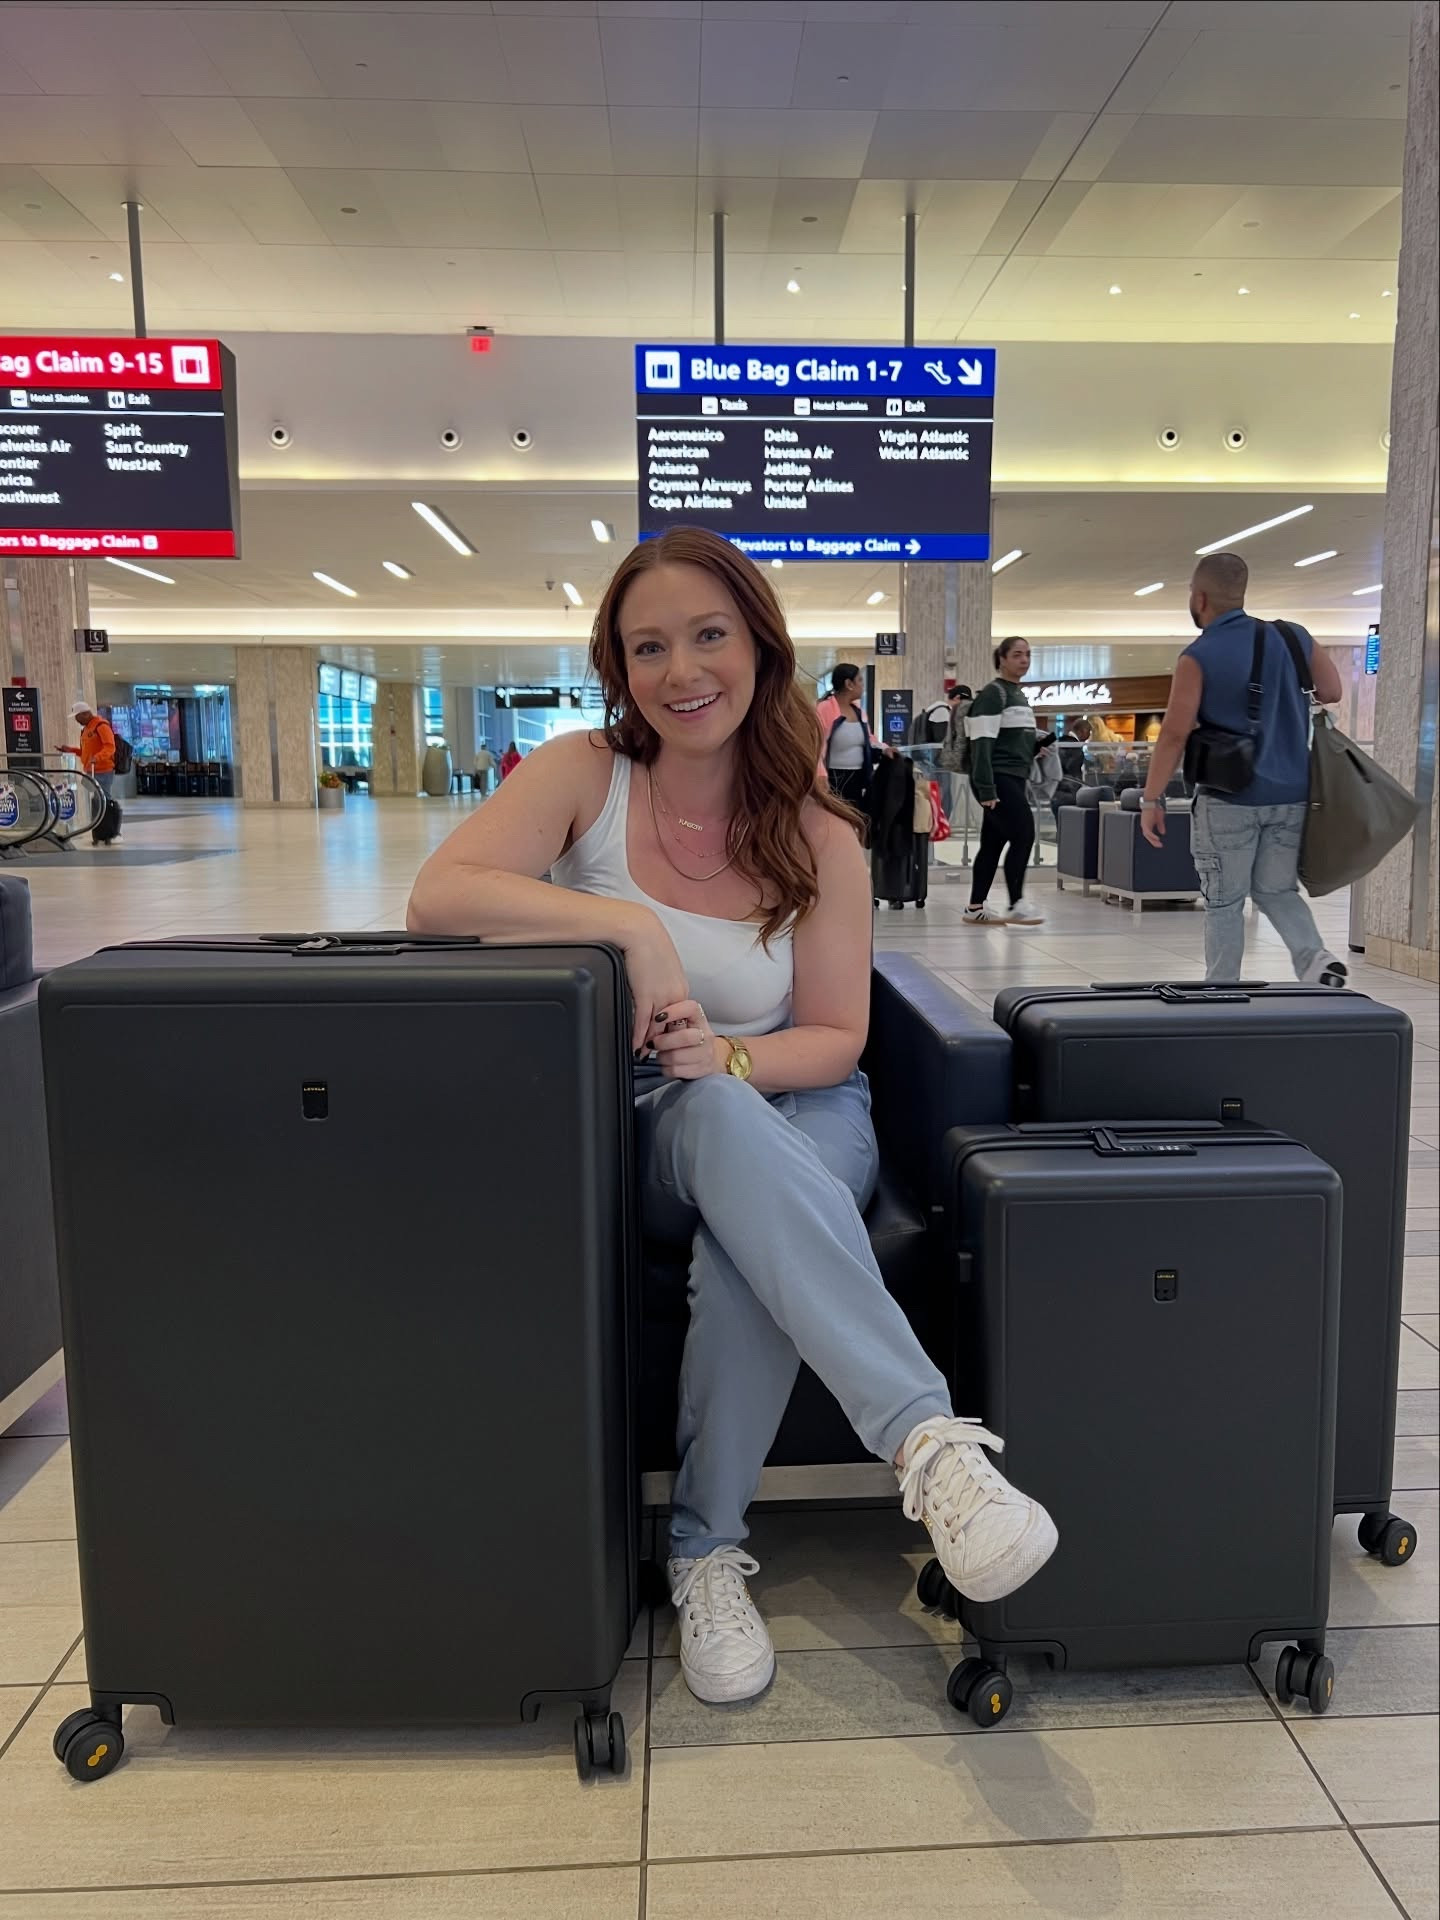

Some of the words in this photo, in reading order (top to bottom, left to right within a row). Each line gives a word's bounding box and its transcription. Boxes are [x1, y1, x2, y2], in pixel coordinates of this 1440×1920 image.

[36, 350, 104, 373] Claim
[108, 352, 164, 374] 9-15
[691, 358, 741, 380] Blue
[747, 359, 790, 386] Bag
[796, 359, 859, 381] Claim
[867, 360, 903, 382] 1-7
[30, 394, 54, 402] Hotel
[54, 394, 90, 403] Shuttles
[128, 394, 150, 405] Exit
[720, 398, 748, 411] Taxis
[904, 400, 926, 412] Exit
[104, 423, 142, 439] Spirit
[648, 427, 725, 441] Aeromexico
[764, 428, 799, 442] Delta
[879, 429, 918, 446] Virgin
[920, 429, 969, 443] Atlantic
[50, 440, 72, 453] Air
[105, 441, 132, 454] Sun
[134, 441, 189, 457] Country
[648, 444, 710, 458] American
[764, 444, 812, 459] Havana
[813, 444, 835, 459] Air
[879, 446, 918, 460] World
[920, 446, 969, 460] Atlantic
[106, 458, 162, 471] WestJet
[648, 460, 699, 475] Avianca
[763, 461, 811, 476] JetBlue
[648, 477, 700, 495] Cayman
[701, 477, 752, 495] Airways
[764, 477, 805, 493] Porter
[805, 477, 855, 493] Airlines
[648, 494, 683, 511] Copa
[683, 494, 733, 509] Airlines
[764, 494, 807, 509] United
[21, 535, 37, 547] to
[39, 534, 99, 550] Baggage
[101, 535, 141, 548] Claim
[789, 539, 804, 551] to
[806, 538, 862, 555] Baggage
[864, 538, 900, 552] Claim
